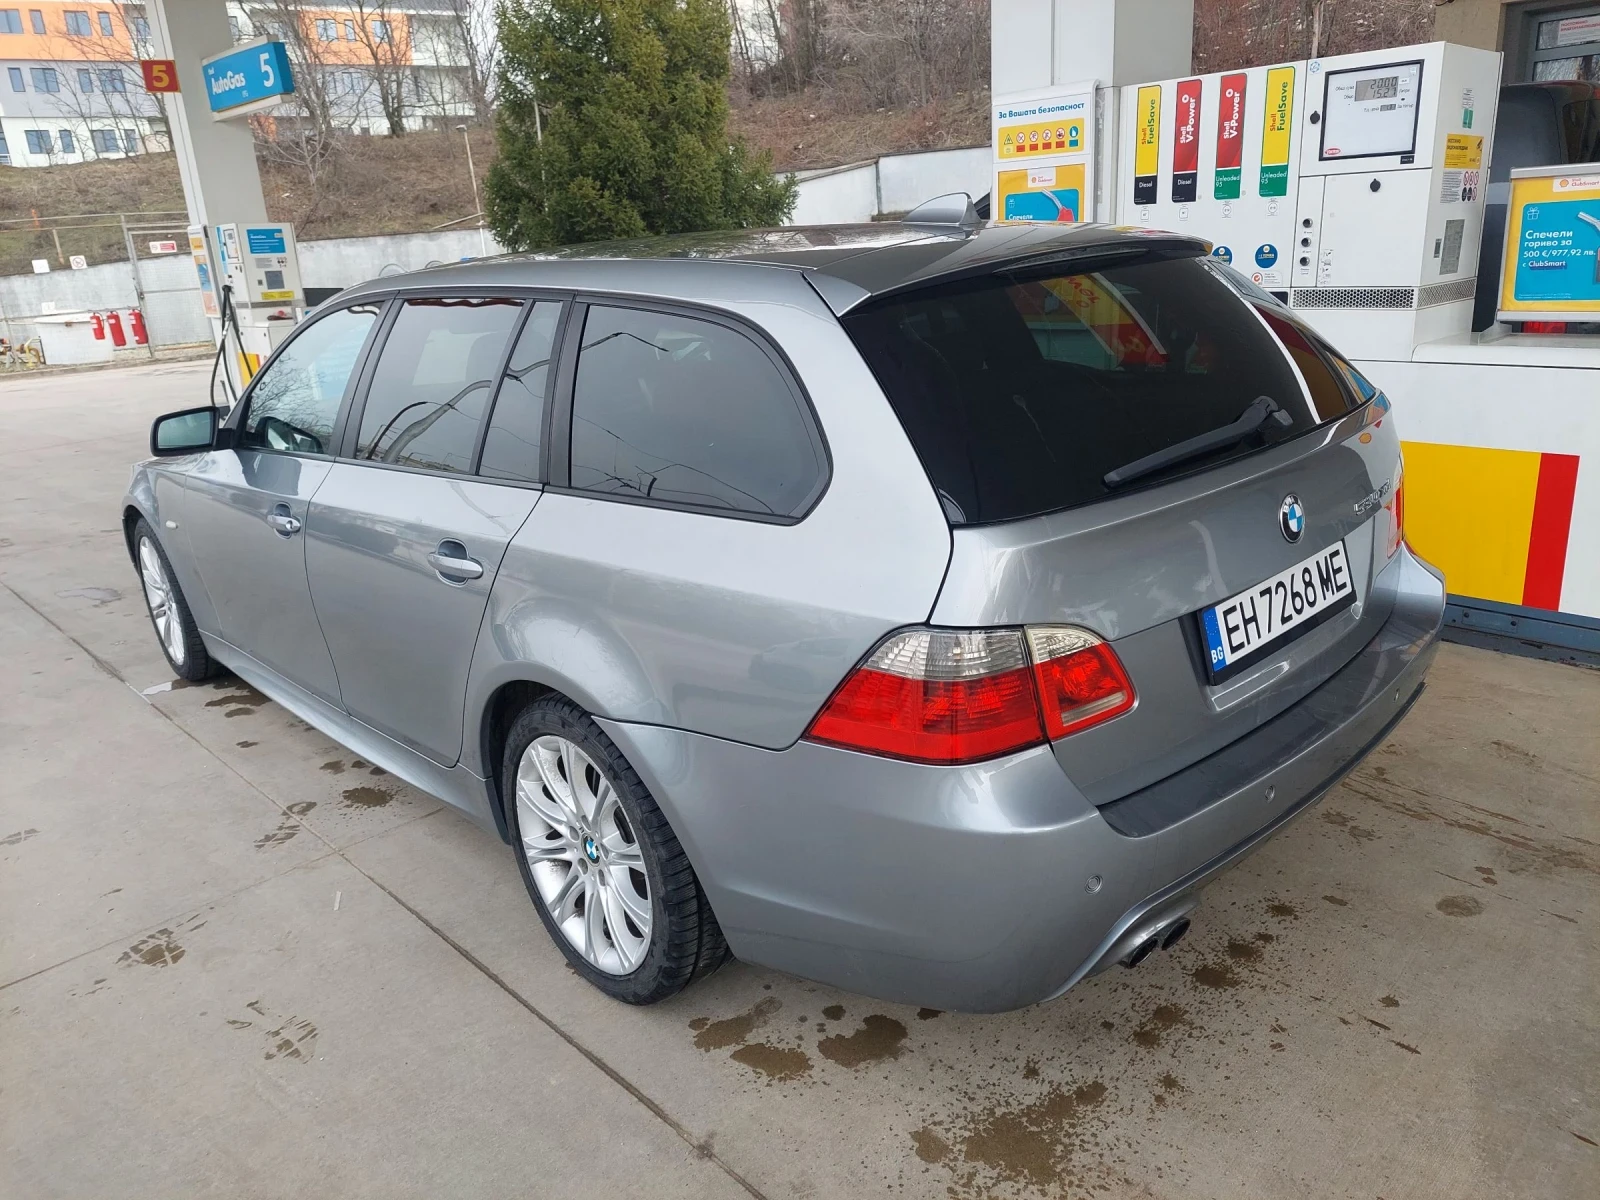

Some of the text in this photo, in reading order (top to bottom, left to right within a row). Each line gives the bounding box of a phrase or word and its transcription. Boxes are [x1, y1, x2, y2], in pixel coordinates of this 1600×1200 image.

[152, 65, 170, 88] 5
[259, 52, 275, 88] 5
[211, 70, 246, 96] AutoGas
[998, 102, 1085, 119] За Вашата безопасност
[1229, 91, 1240, 139] V-Power
[1276, 81, 1288, 131] FuelSave
[1147, 99, 1156, 144] FuelSave
[1186, 97, 1196, 143] V-Power
[1177, 178, 1192, 186] Diesel
[1260, 171, 1287, 179] Unleaded
[1524, 240, 1559, 249] гориво
[1525, 230, 1573, 239] Спечели
[1523, 250, 1540, 258] 500
[1541, 248, 1582, 258] €/977,92
[1210, 646, 1224, 664] BG
